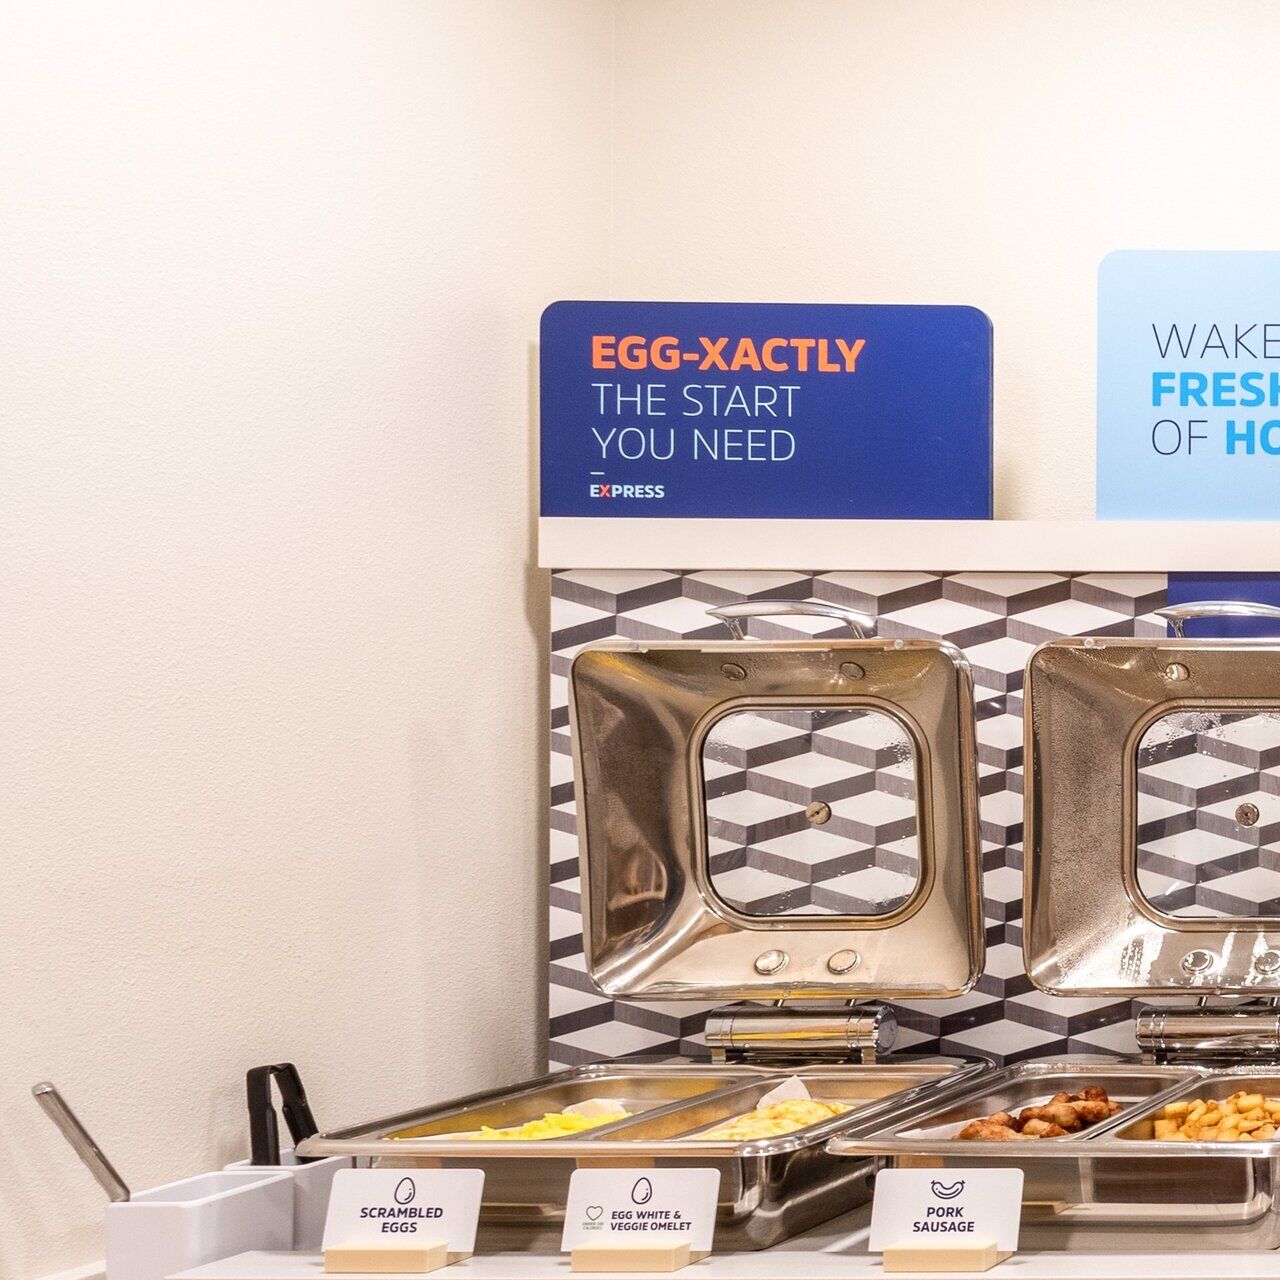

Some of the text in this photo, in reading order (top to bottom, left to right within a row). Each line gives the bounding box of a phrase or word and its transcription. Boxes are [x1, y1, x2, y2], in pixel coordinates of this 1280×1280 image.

[592, 335, 866, 373] EGG-XACTLY
[591, 383, 801, 417] THE START
[1152, 419, 1208, 455] OF
[592, 427, 795, 461] YOU NEED
[590, 484, 665, 498] EXPRESS
[360, 1207, 443, 1218] SCRAMBLED
[611, 1211, 681, 1220] EGG WHITE &
[926, 1207, 964, 1218] PORK
[381, 1222, 418, 1233] EGGS
[610, 1222, 650, 1231] VEGGIE
[651, 1222, 692, 1231] OMELET
[913, 1221, 975, 1232] SAUSAGE
